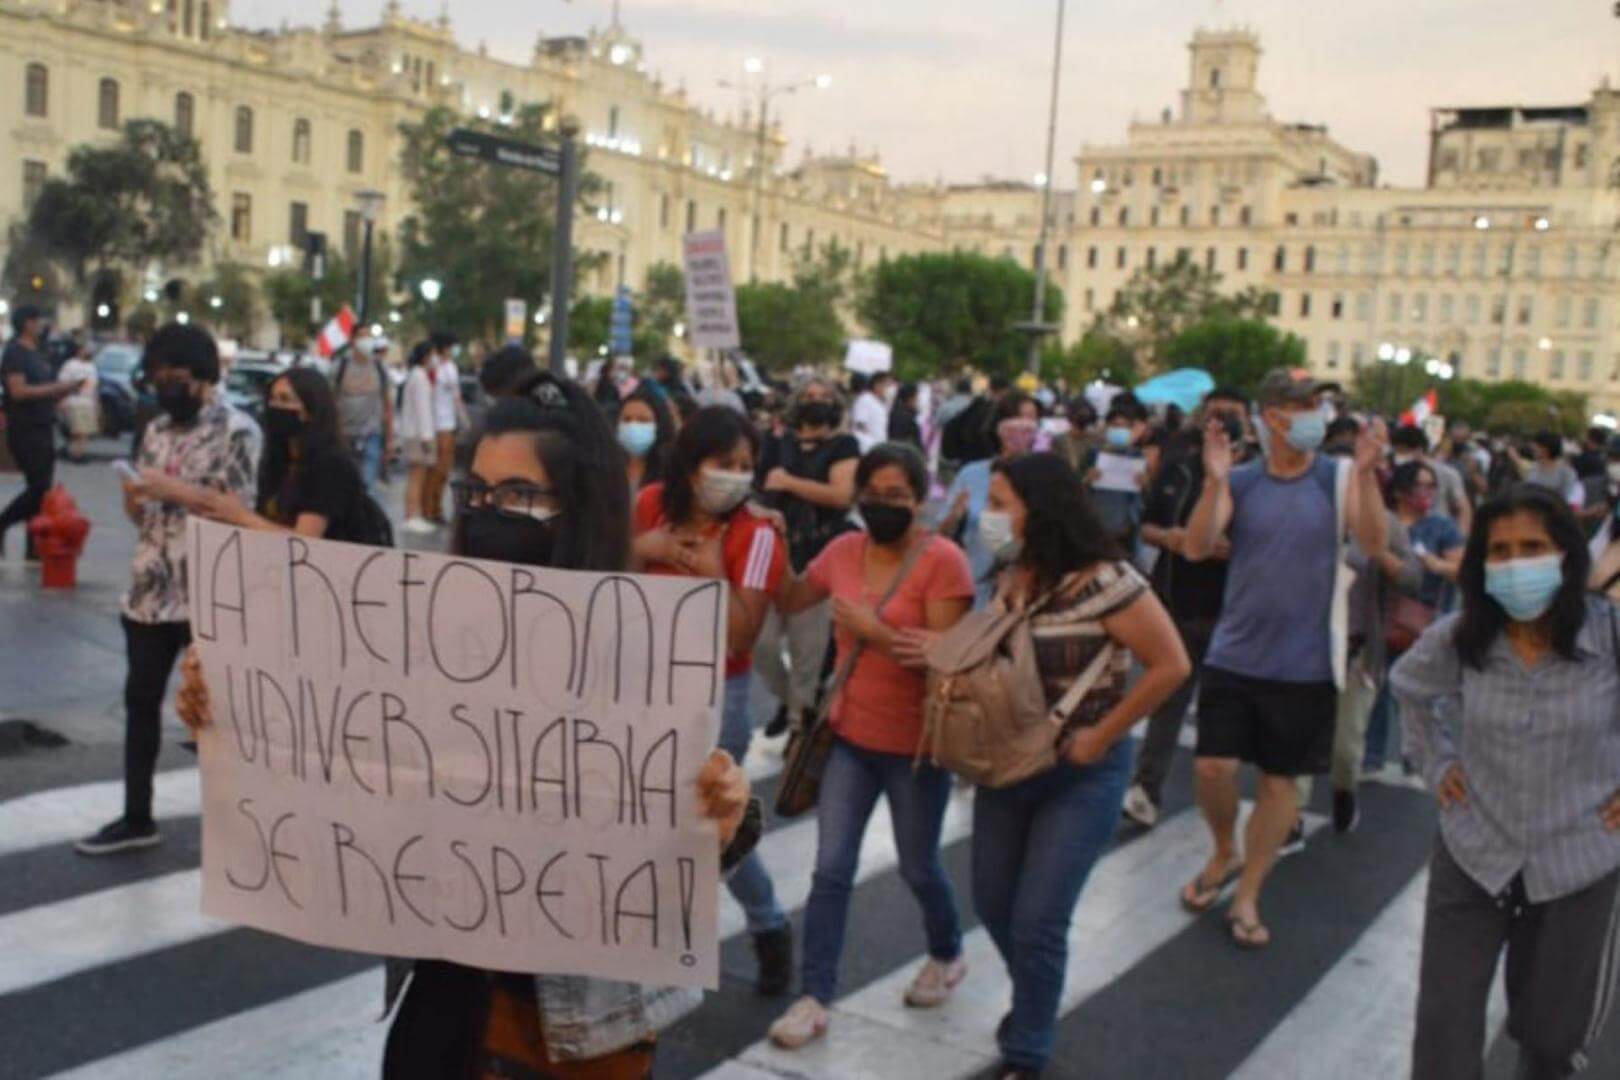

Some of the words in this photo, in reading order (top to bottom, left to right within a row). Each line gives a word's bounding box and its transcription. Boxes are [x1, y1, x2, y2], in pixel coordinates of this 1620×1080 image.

[196, 522, 247, 645] LA
[288, 538, 722, 706] REFORMA
[227, 664, 678, 828] UNIVERSITARIA
[226, 799, 304, 909] SE
[332, 822, 697, 967] RESPETA!
